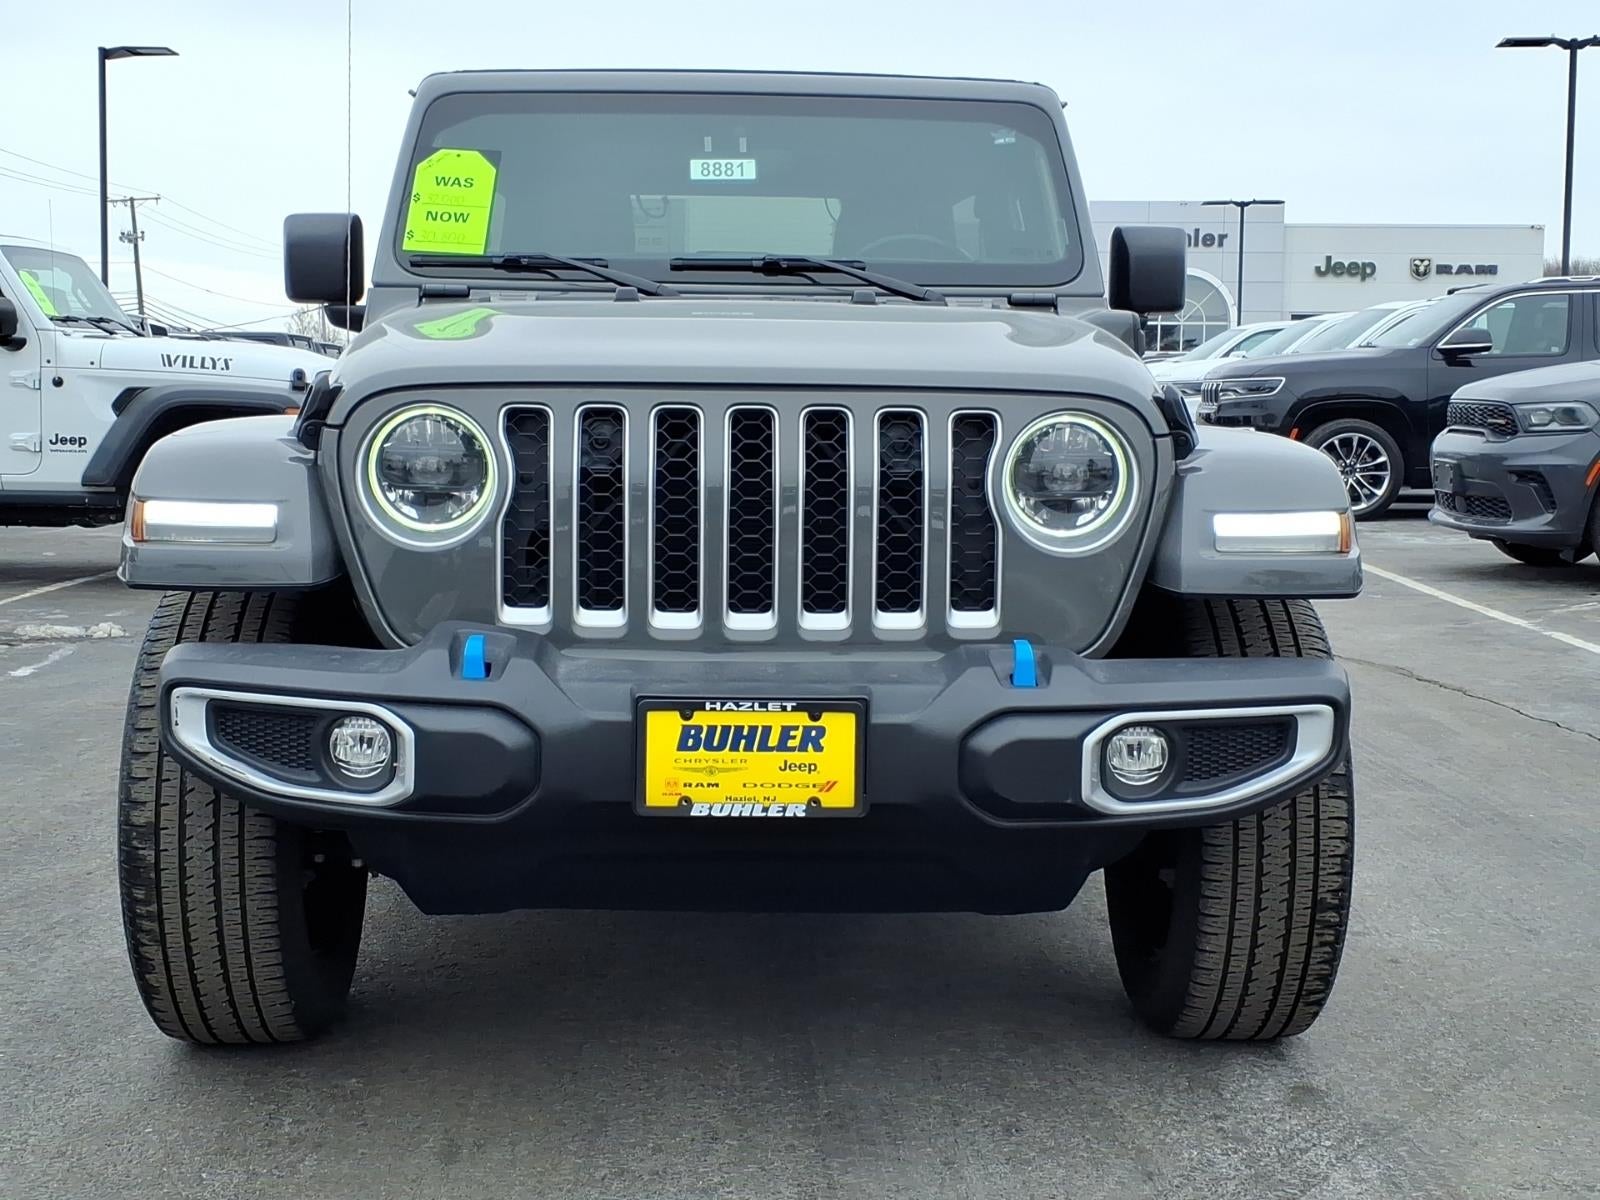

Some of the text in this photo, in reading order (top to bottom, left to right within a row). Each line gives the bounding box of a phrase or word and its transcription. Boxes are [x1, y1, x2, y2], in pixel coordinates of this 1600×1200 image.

[700, 161, 746, 178] 8881
[435, 176, 475, 188] WAS
[425, 210, 471, 223] NOW
[1314, 255, 1376, 281] Jeep
[1435, 264, 1498, 275] RAM
[161, 353, 233, 371] WILLYS
[49, 433, 88, 448] Jeep
[705, 701, 797, 711] HAZLET
[676, 724, 826, 752] BUHLER
[779, 760, 818, 774] Jeep
[690, 803, 806, 817] BUHLER
